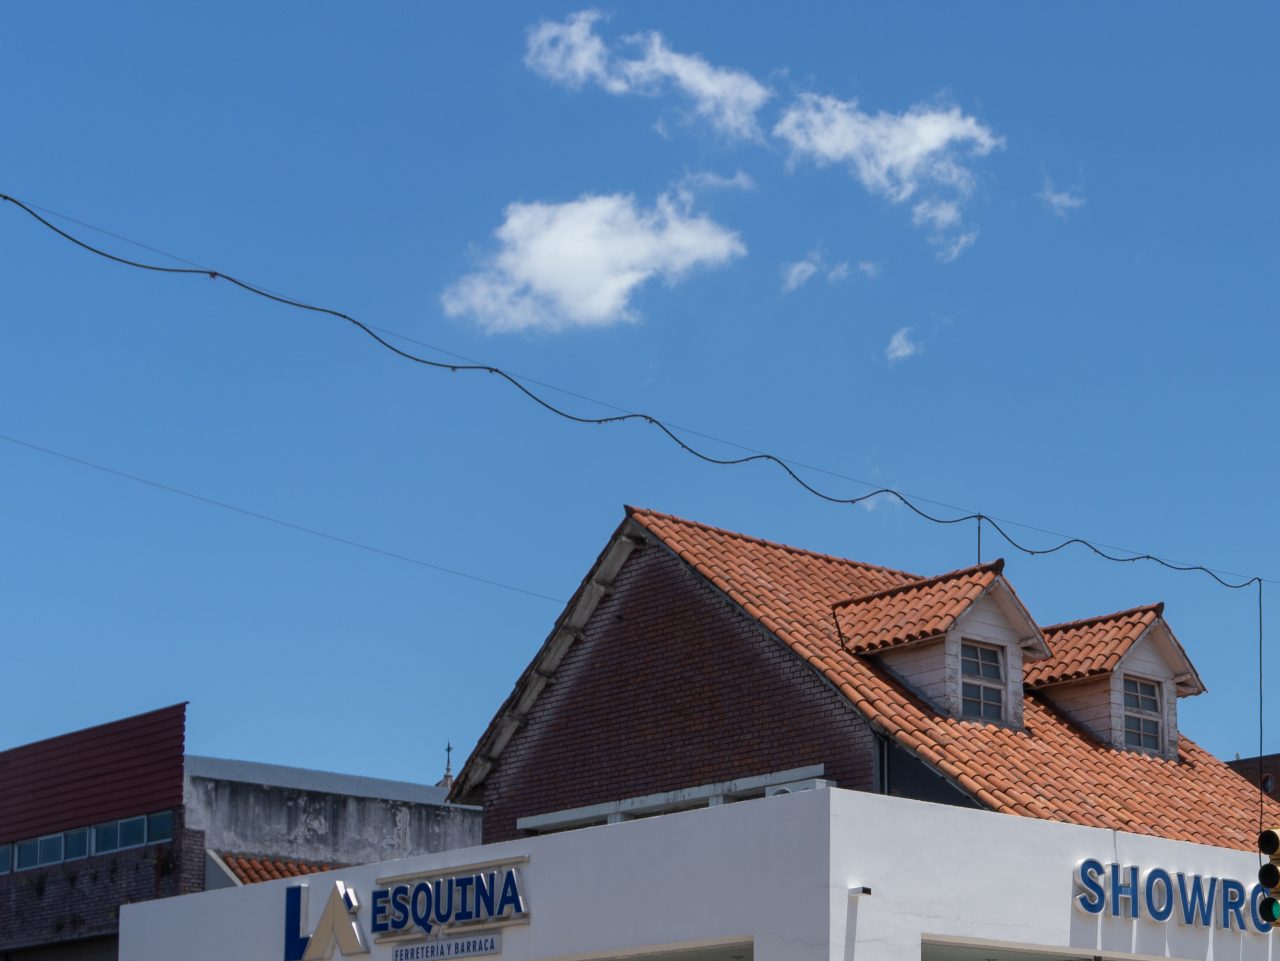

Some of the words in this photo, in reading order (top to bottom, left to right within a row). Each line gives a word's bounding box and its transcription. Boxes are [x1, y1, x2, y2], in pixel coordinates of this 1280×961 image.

[284, 881, 371, 961] LA
[371, 868, 525, 934] ESQUINA
[395, 942, 444, 961] FERRETERÍA
[447, 943, 451, 956] Y
[454, 938, 495, 954] BARRACA
